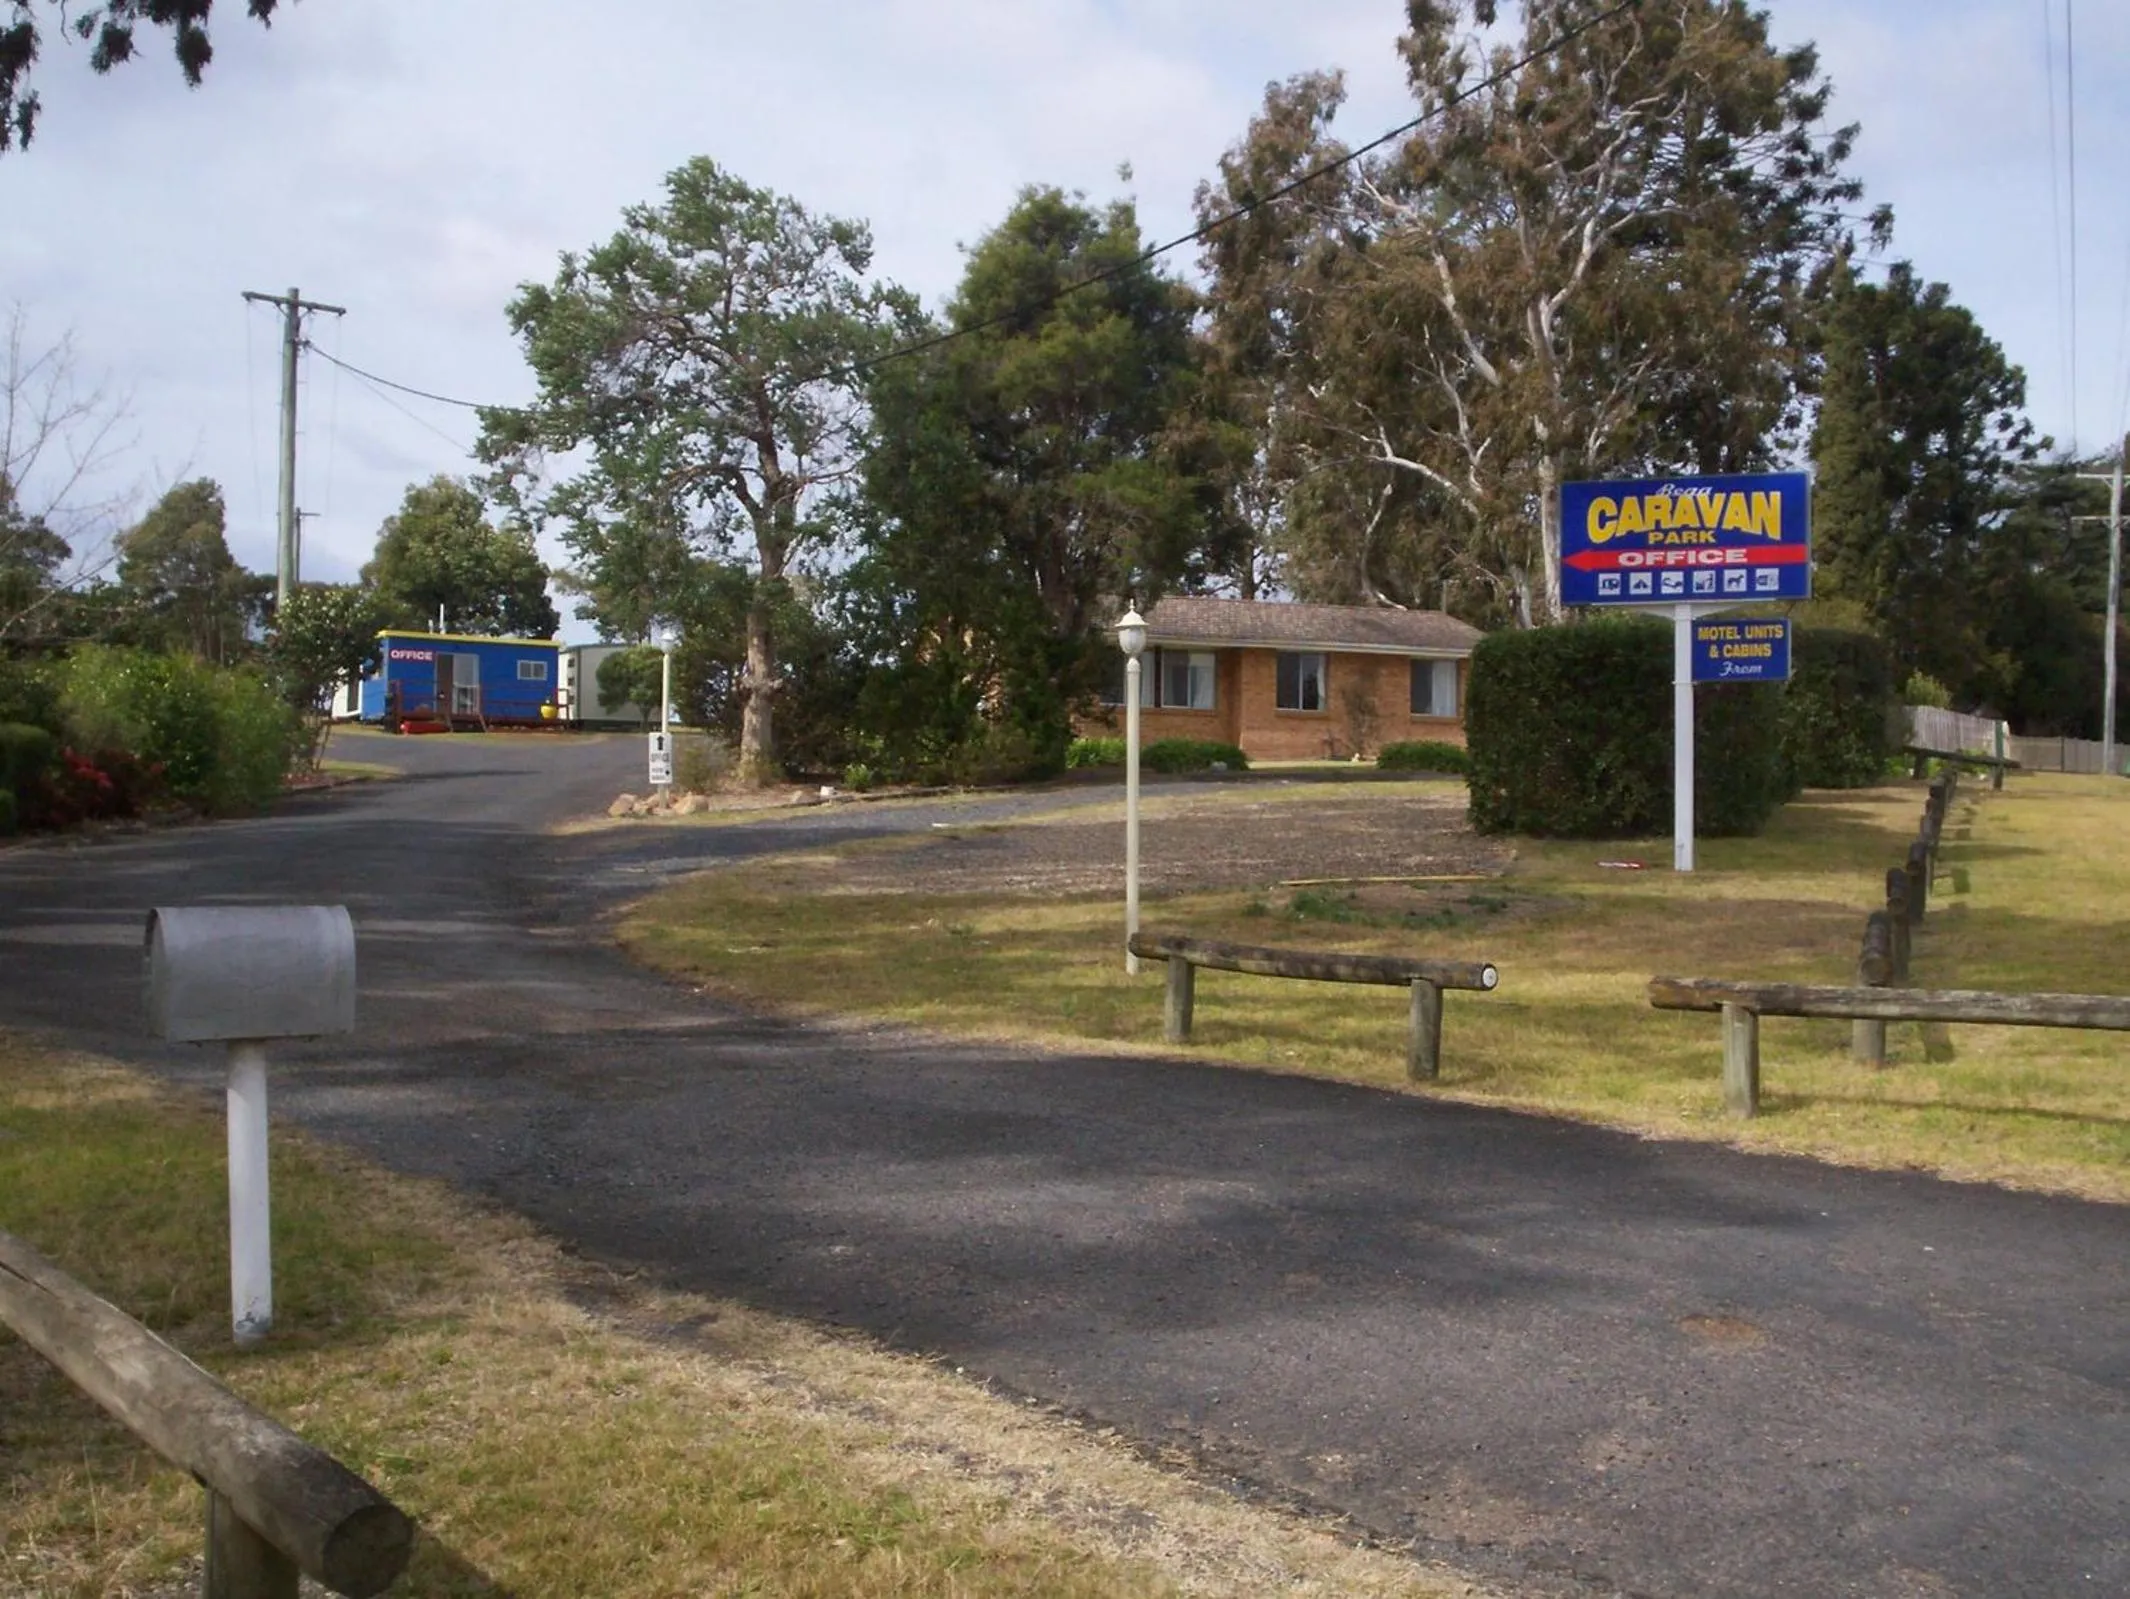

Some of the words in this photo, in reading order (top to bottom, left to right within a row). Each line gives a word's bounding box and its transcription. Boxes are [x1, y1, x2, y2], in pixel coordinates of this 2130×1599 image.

[1587, 491, 1781, 544] CARAVAN
[1648, 529, 1716, 544] PARK
[1618, 548, 1748, 566] OFFICE
[1698, 626, 1741, 639] MOTEL
[1745, 624, 1784, 638] UNITS
[391, 649, 433, 661] OFFICE
[1709, 645, 1719, 657] &
[1723, 643, 1772, 657] CABINS
[1719, 661, 1762, 676] From
